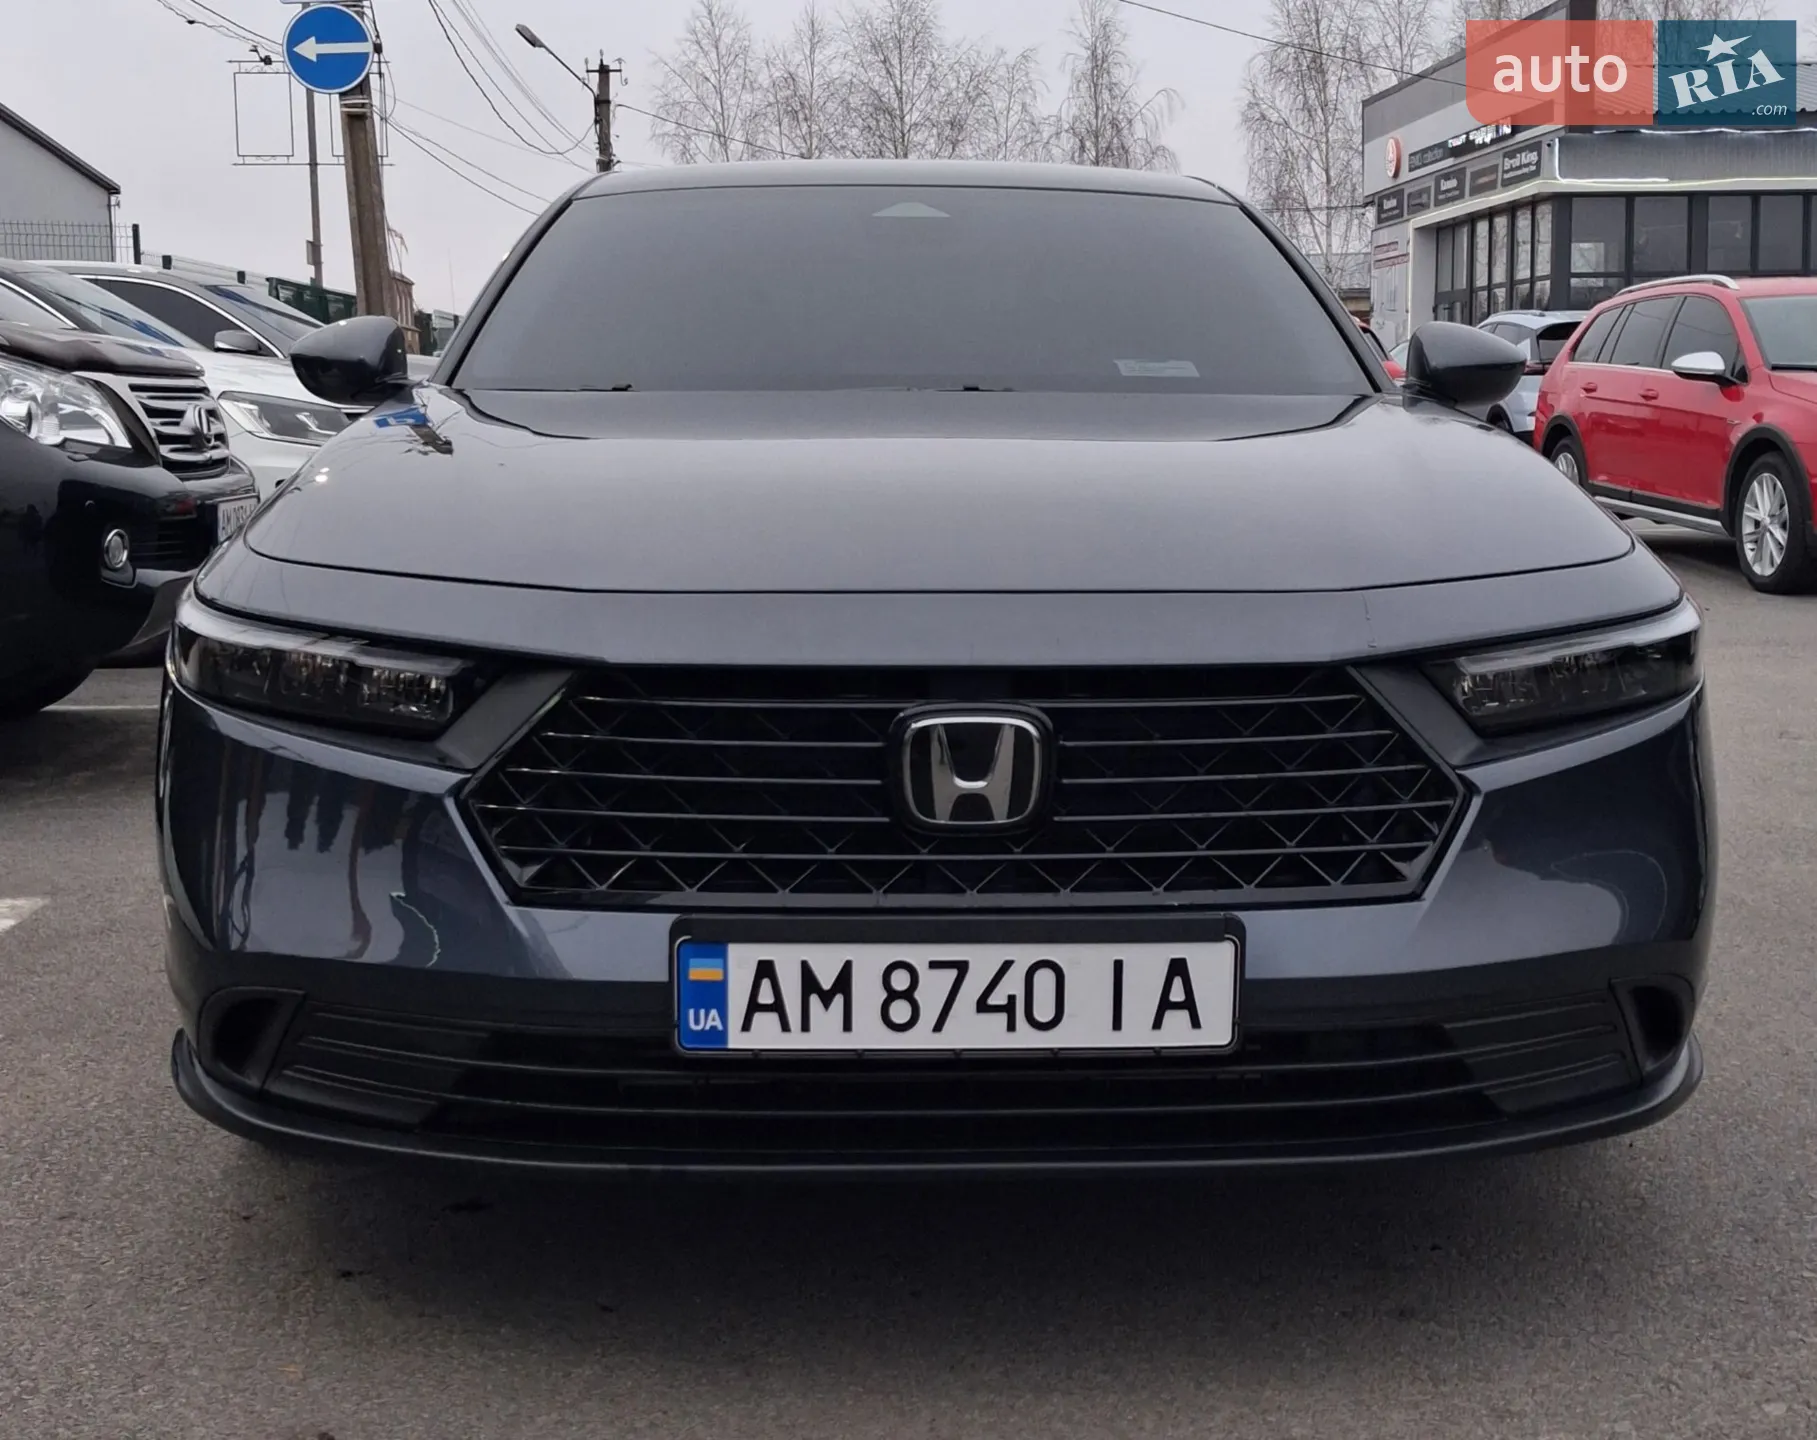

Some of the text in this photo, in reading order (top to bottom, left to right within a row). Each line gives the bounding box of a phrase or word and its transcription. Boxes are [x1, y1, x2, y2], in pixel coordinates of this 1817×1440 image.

[688, 1009, 723, 1031] UA
[740, 959, 853, 1033] AM
[880, 959, 1065, 1033] 8740
